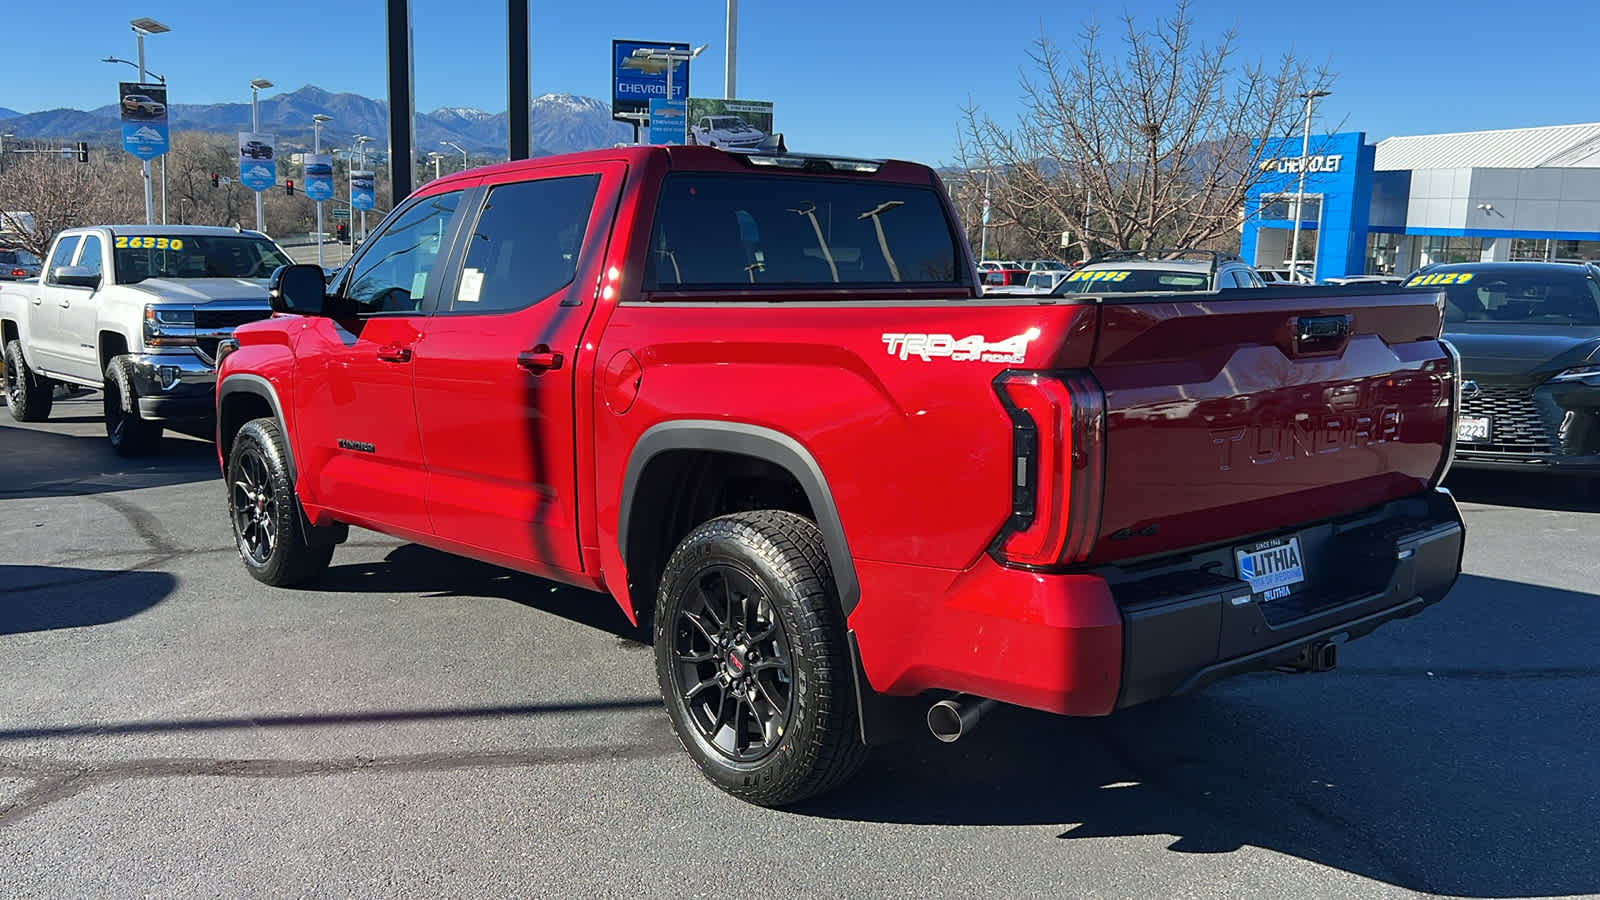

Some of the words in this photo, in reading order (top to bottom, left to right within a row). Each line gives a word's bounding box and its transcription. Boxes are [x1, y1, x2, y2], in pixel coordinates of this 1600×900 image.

[618, 82, 682, 96] CHEVROLET
[1277, 154, 1342, 174] CHEVROLET
[115, 236, 183, 251] 26330
[1209, 405, 1402, 472] TUNDRA
[1253, 547, 1299, 577] LITHIA
